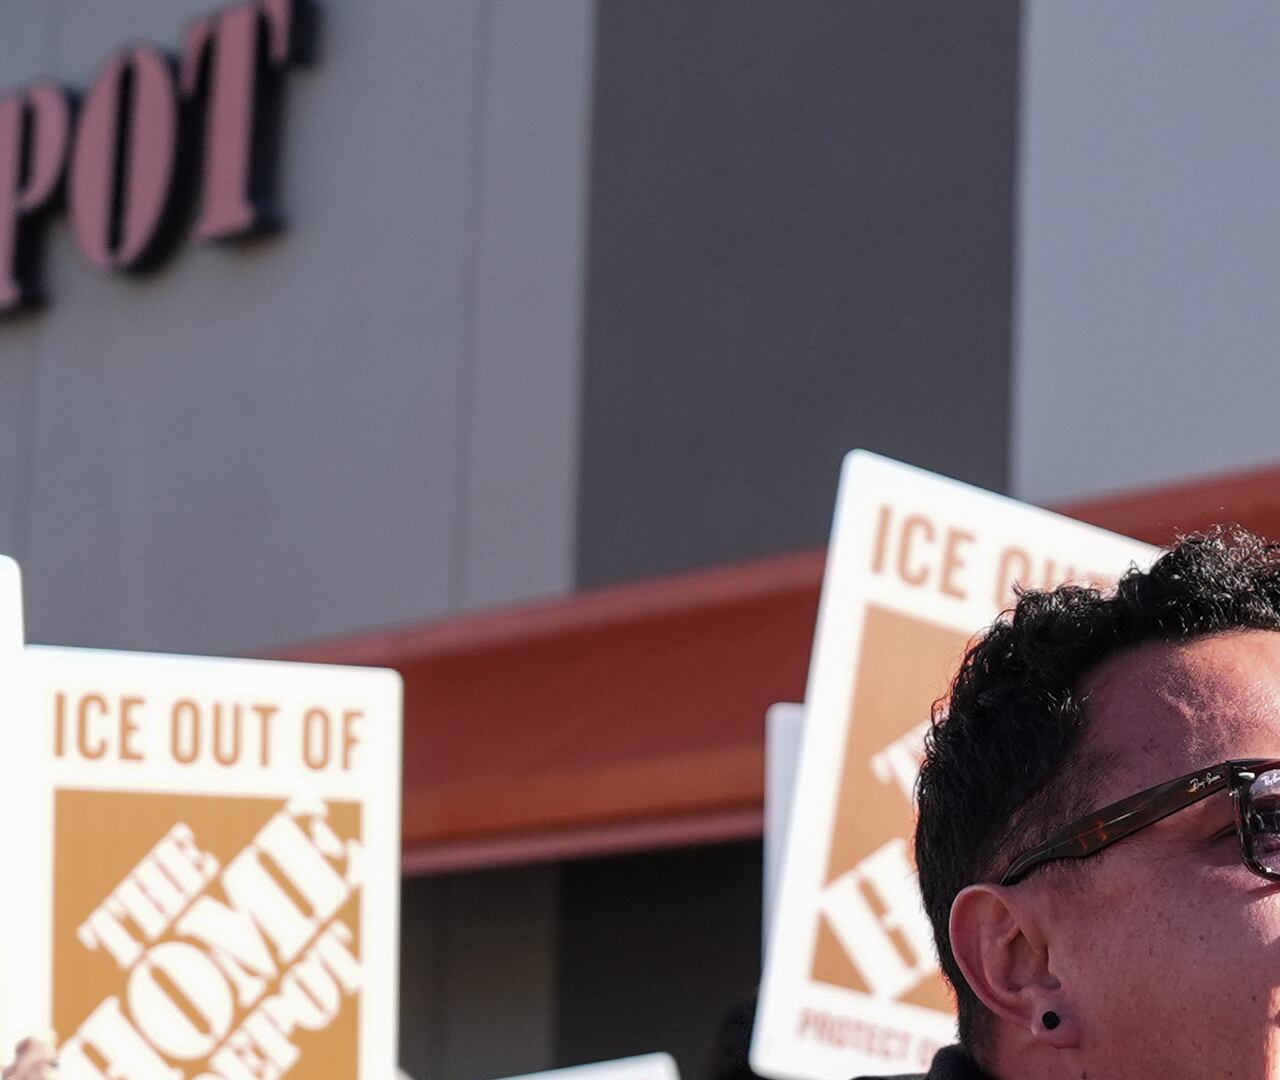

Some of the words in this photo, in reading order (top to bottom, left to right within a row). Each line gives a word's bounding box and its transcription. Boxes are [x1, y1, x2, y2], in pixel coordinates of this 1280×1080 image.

[870, 504, 975, 600] ICE
[54, 691, 145, 761] ICE
[171, 700, 278, 767] OUT
[302, 708, 365, 770] OF
[77, 821, 219, 968] THE
